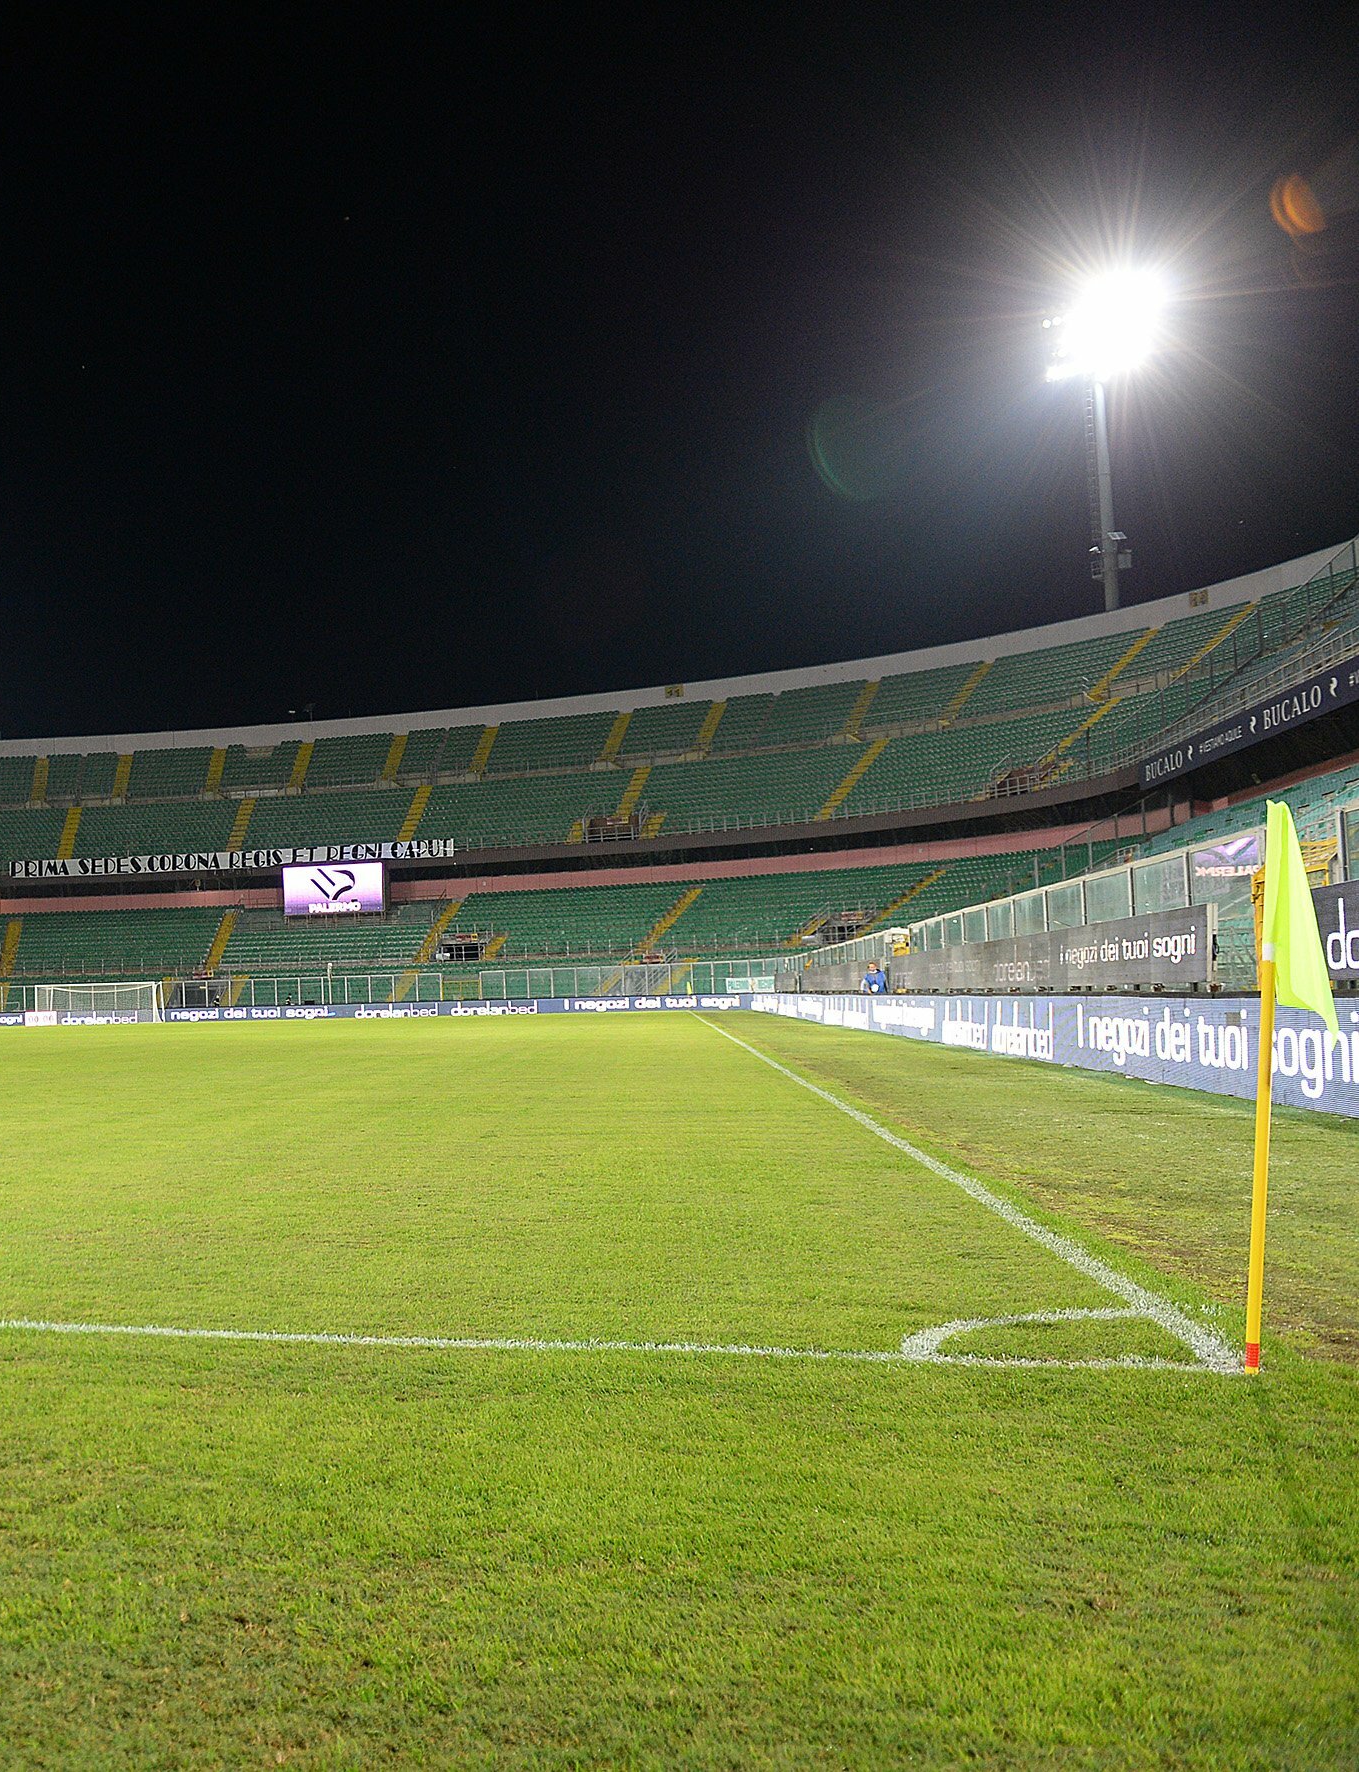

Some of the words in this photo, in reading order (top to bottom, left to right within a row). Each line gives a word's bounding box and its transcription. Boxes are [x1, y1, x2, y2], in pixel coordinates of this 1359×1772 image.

[1263, 685, 1322, 730] BUCALO
[1145, 750, 1183, 782] BUCALO
[10, 859, 70, 877] PRIMA
[229, 849, 283, 869] REGIS
[292, 846, 319, 863] ET
[326, 843, 383, 861] REGNI
[390, 839, 451, 859] CAPUT
[308, 901, 361, 913] PALERMO
[1065, 940, 1098, 970] negozi
[1100, 936, 1119, 962] dei
[1122, 932, 1149, 961] tuoi
[1152, 925, 1197, 964] sogni
[170, 1007, 220, 1022] negozi
[224, 1007, 247, 1019] dei
[251, 1006, 281, 1019] tuoi
[285, 1005, 329, 1020] sogni
[354, 1002, 438, 1019] dorelanbed
[450, 1000, 538, 1017] dorelanbed
[574, 997, 630, 1012] negozi
[634, 996, 661, 1009] dei
[664, 995, 698, 1008] tuoi
[700, 994, 740, 1010] sogni
[1088, 1006, 1150, 1067] negozi
[1155, 1006, 1191, 1063] dei
[1197, 1008, 1249, 1071] tuoi
